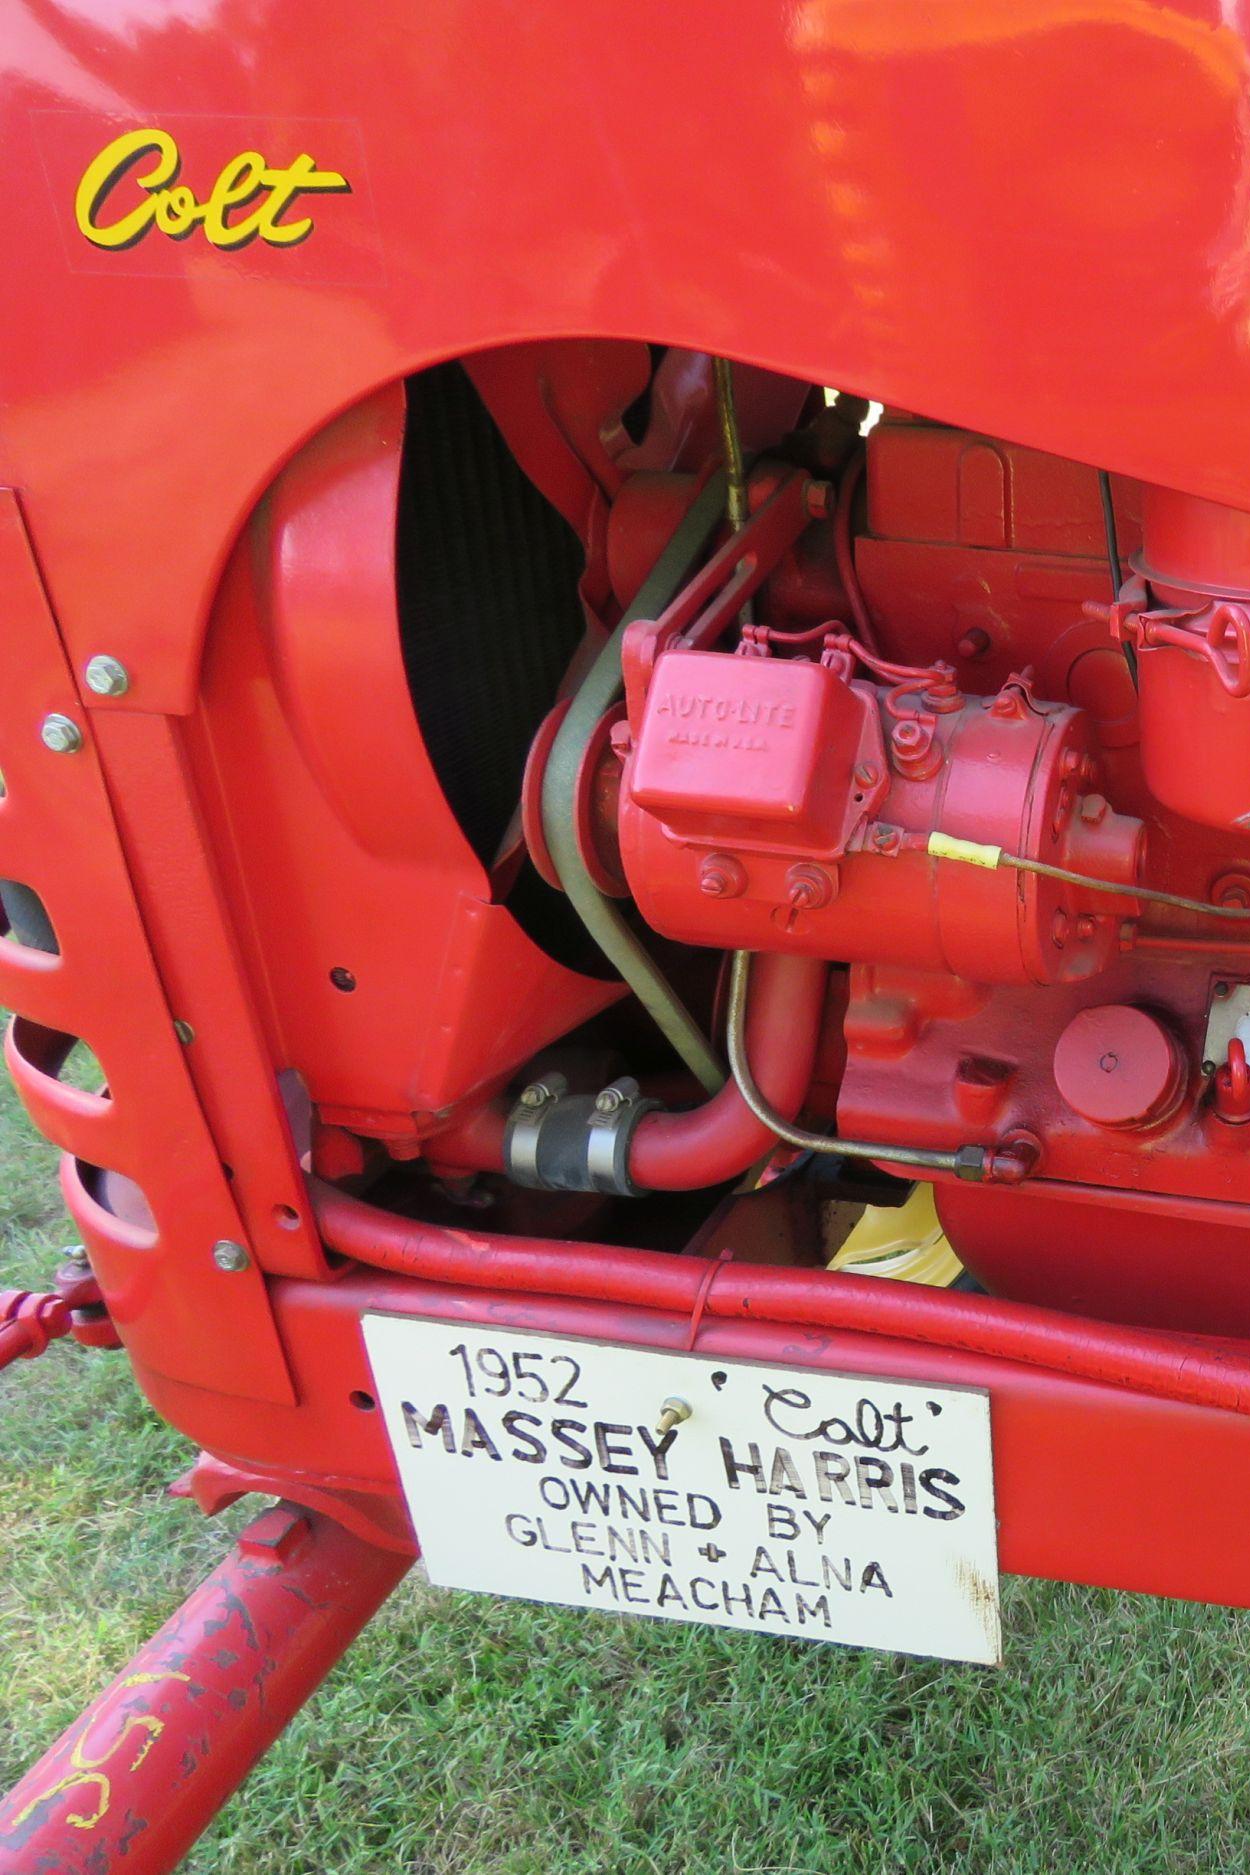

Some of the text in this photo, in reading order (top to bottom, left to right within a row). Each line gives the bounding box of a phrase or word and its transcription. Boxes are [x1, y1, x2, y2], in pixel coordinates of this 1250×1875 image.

[75, 128, 352, 251] Colt
[449, 1343, 589, 1408] 1952
[400, 1401, 966, 1521] MASSEY HARRIS
[538, 1475, 832, 1545] OWNED BY
[504, 1513, 672, 1566] GLENN
[750, 1546, 895, 1599] ALNA
[581, 1562, 833, 1629] MEACHAM
